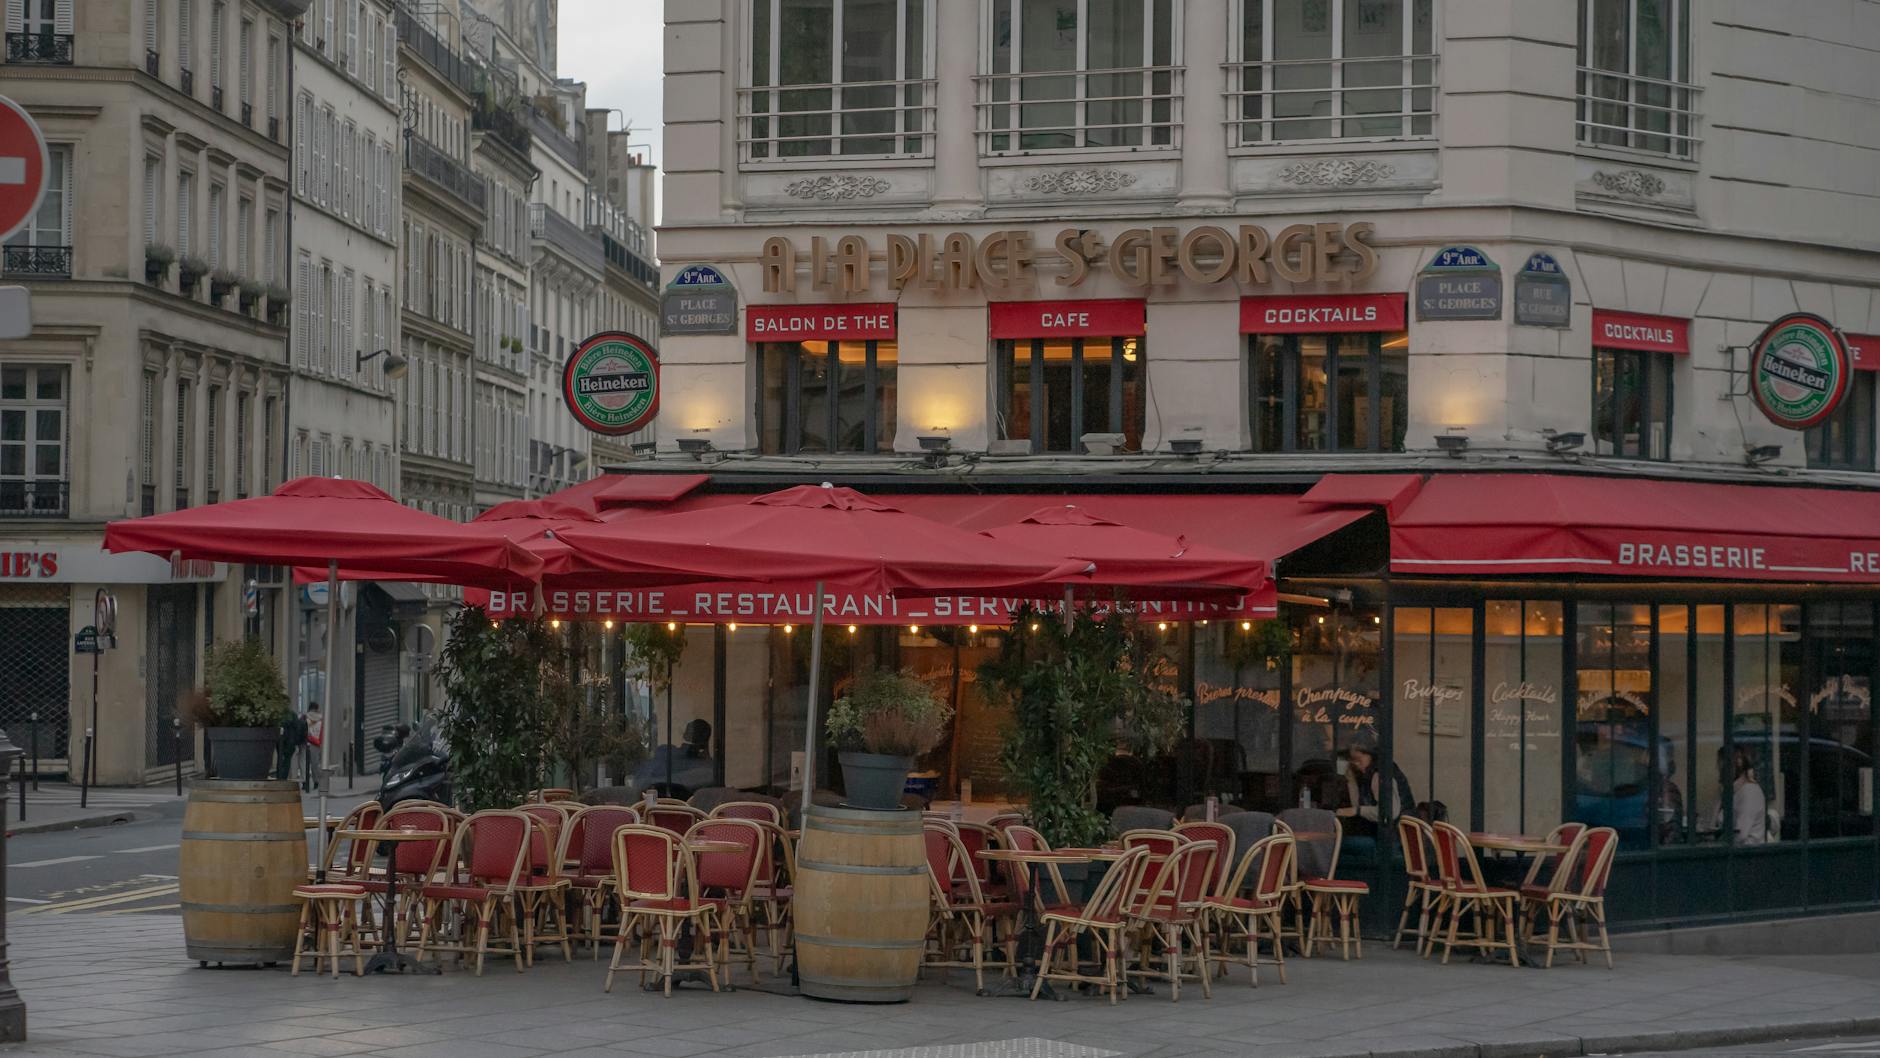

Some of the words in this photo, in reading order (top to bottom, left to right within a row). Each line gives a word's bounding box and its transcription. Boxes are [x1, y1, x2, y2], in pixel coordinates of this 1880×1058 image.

[760, 236, 795, 292] A
[811, 235, 871, 292] LA
[887, 231, 1033, 290] PLACE
[1109, 222, 1379, 288] GEORGES
[1439, 282, 1481, 294] PLACE
[680, 299, 718, 310] PLACE
[1438, 297, 1497, 310] GEORGES
[679, 312, 731, 325] GEORGES
[755, 317, 816, 332] SALON
[824, 316, 848, 331] DE
[854, 315, 890, 330] THE
[1041, 312, 1089, 328] CAFE
[1265, 306, 1377, 324] COCKTAILS
[1605, 323, 1674, 343] COCKTAILS
[602, 345, 643, 369] Heineken
[1763, 355, 1825, 389] Heineken
[580, 376, 647, 392] Heineken
[1618, 543, 1766, 569] BRASSERIE
[1297, 687, 1373, 710] Champagne
[1402, 678, 1464, 707] Burgers
[1491, 681, 1557, 704] Cocktails
[1314, 706, 1332, 723] la
